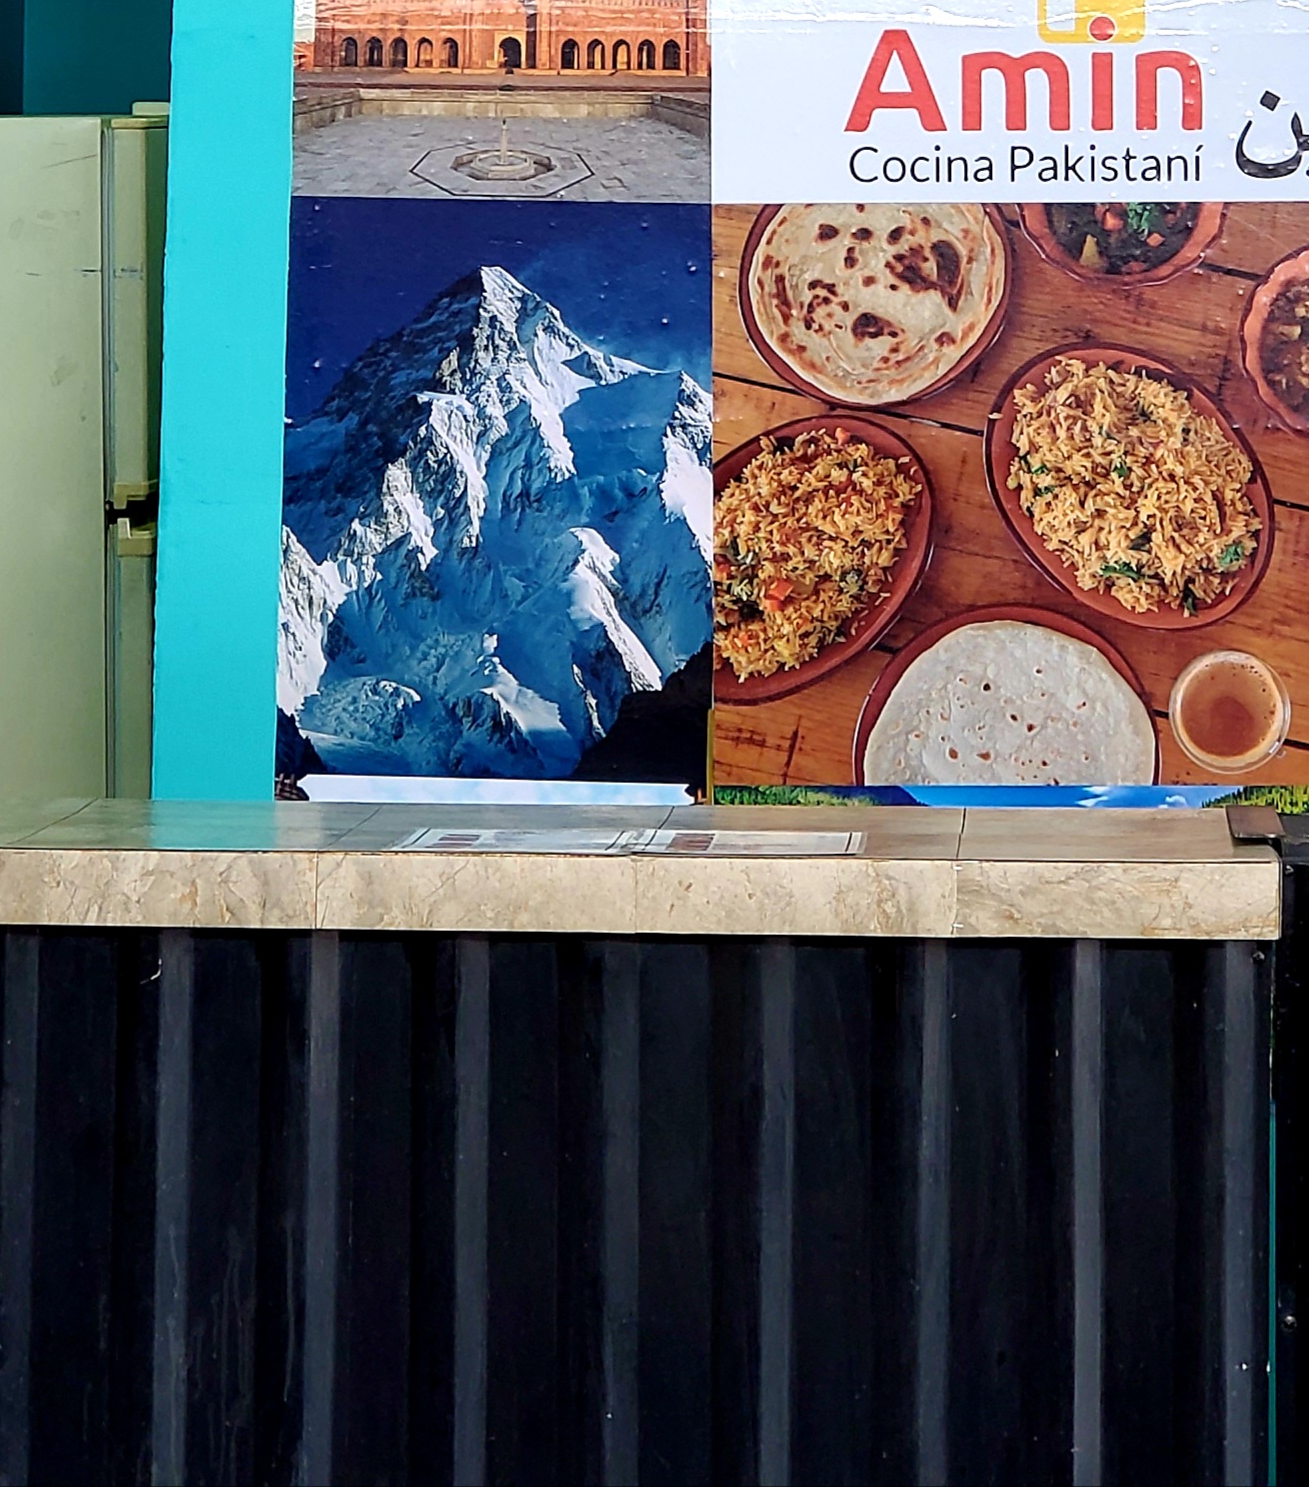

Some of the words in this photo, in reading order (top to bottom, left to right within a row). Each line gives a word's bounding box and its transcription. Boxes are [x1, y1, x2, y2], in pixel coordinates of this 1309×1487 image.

[844, 17, 1204, 133] Amin
[848, 146, 994, 183] Cocina
[1009, 144, 1201, 183] Pakistaní
